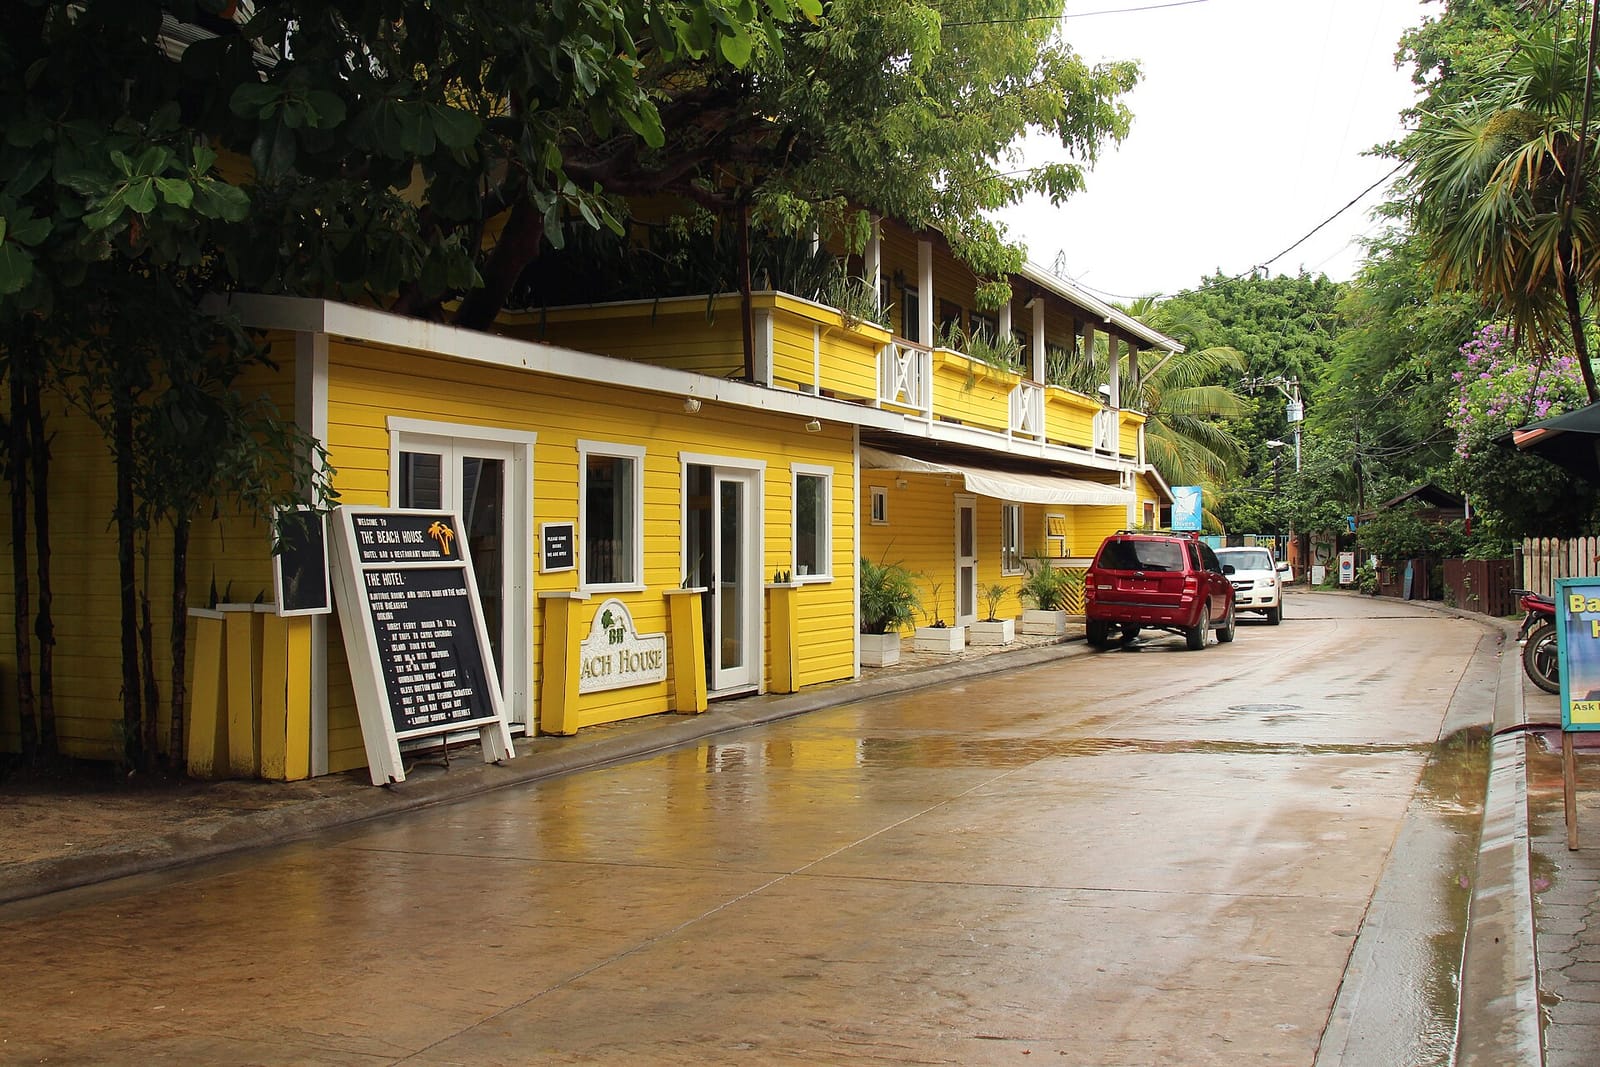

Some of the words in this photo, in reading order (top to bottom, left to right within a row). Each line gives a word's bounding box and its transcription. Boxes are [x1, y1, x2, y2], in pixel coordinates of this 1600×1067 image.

[360, 530, 375, 544] THE
[377, 530, 400, 543] BEACH
[402, 530, 424, 543] HOUSE
[363, 550, 378, 559] HOTEL
[365, 572, 381, 587] THE
[382, 572, 405, 586] HOTEL
[580, 655, 612, 679] ACH
[1573, 703, 1594, 711] Ask
